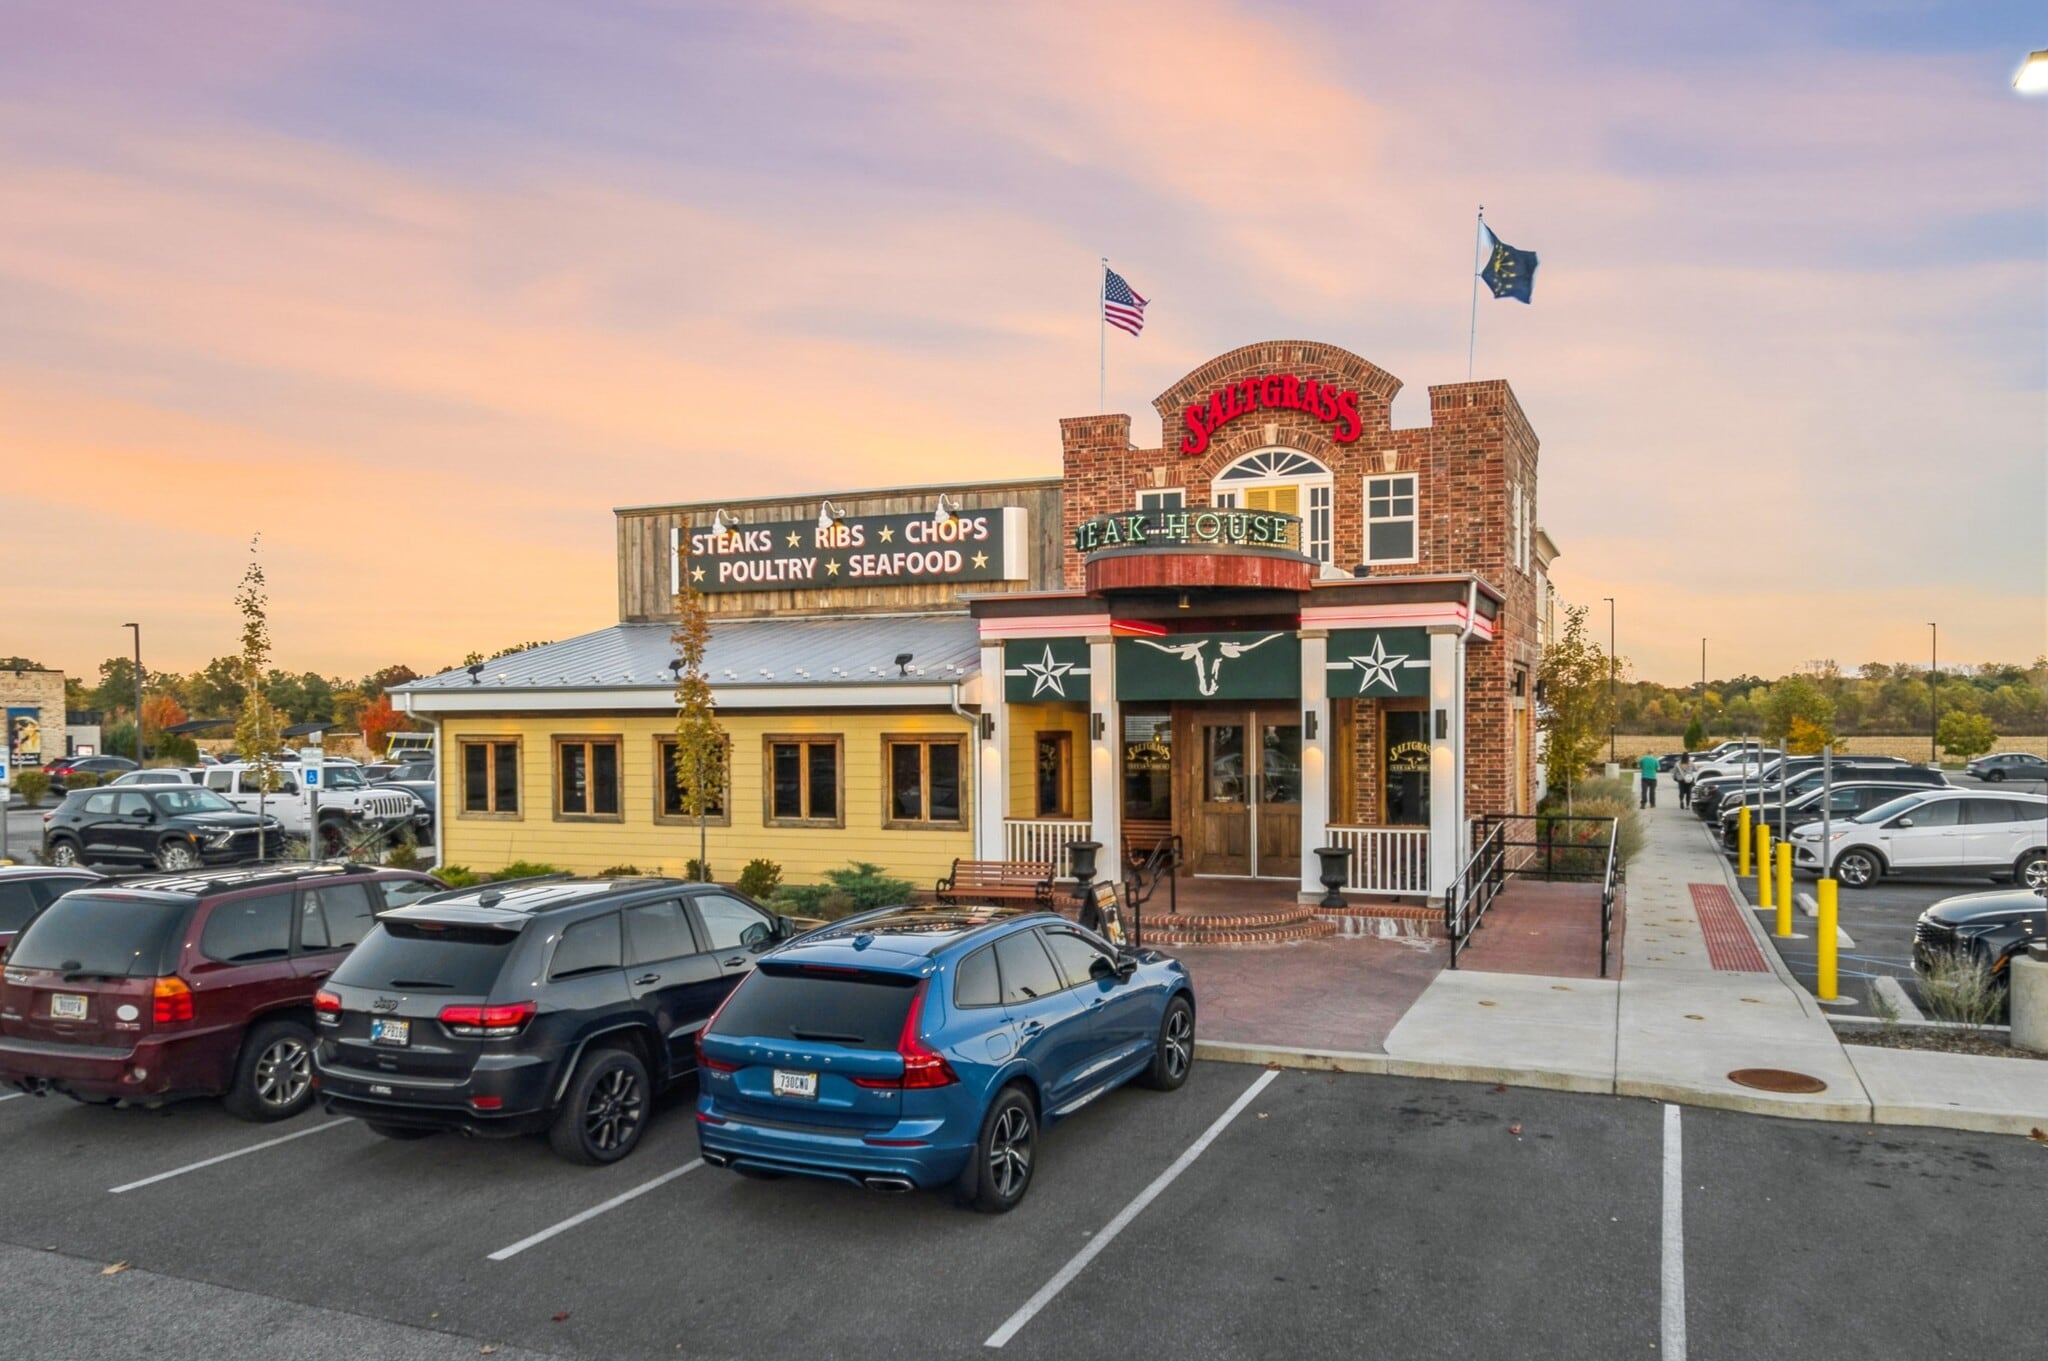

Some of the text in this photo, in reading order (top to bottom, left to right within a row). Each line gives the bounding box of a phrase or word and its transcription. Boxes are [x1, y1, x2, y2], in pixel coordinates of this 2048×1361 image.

[1182, 375, 1362, 455] SALTGRASS
[691, 516, 989, 556] STEAKS RIBS CHOPS
[1077, 513, 1288, 551] TEAK HOUSE
[719, 549, 963, 583] POULTRY SEAFOOD
